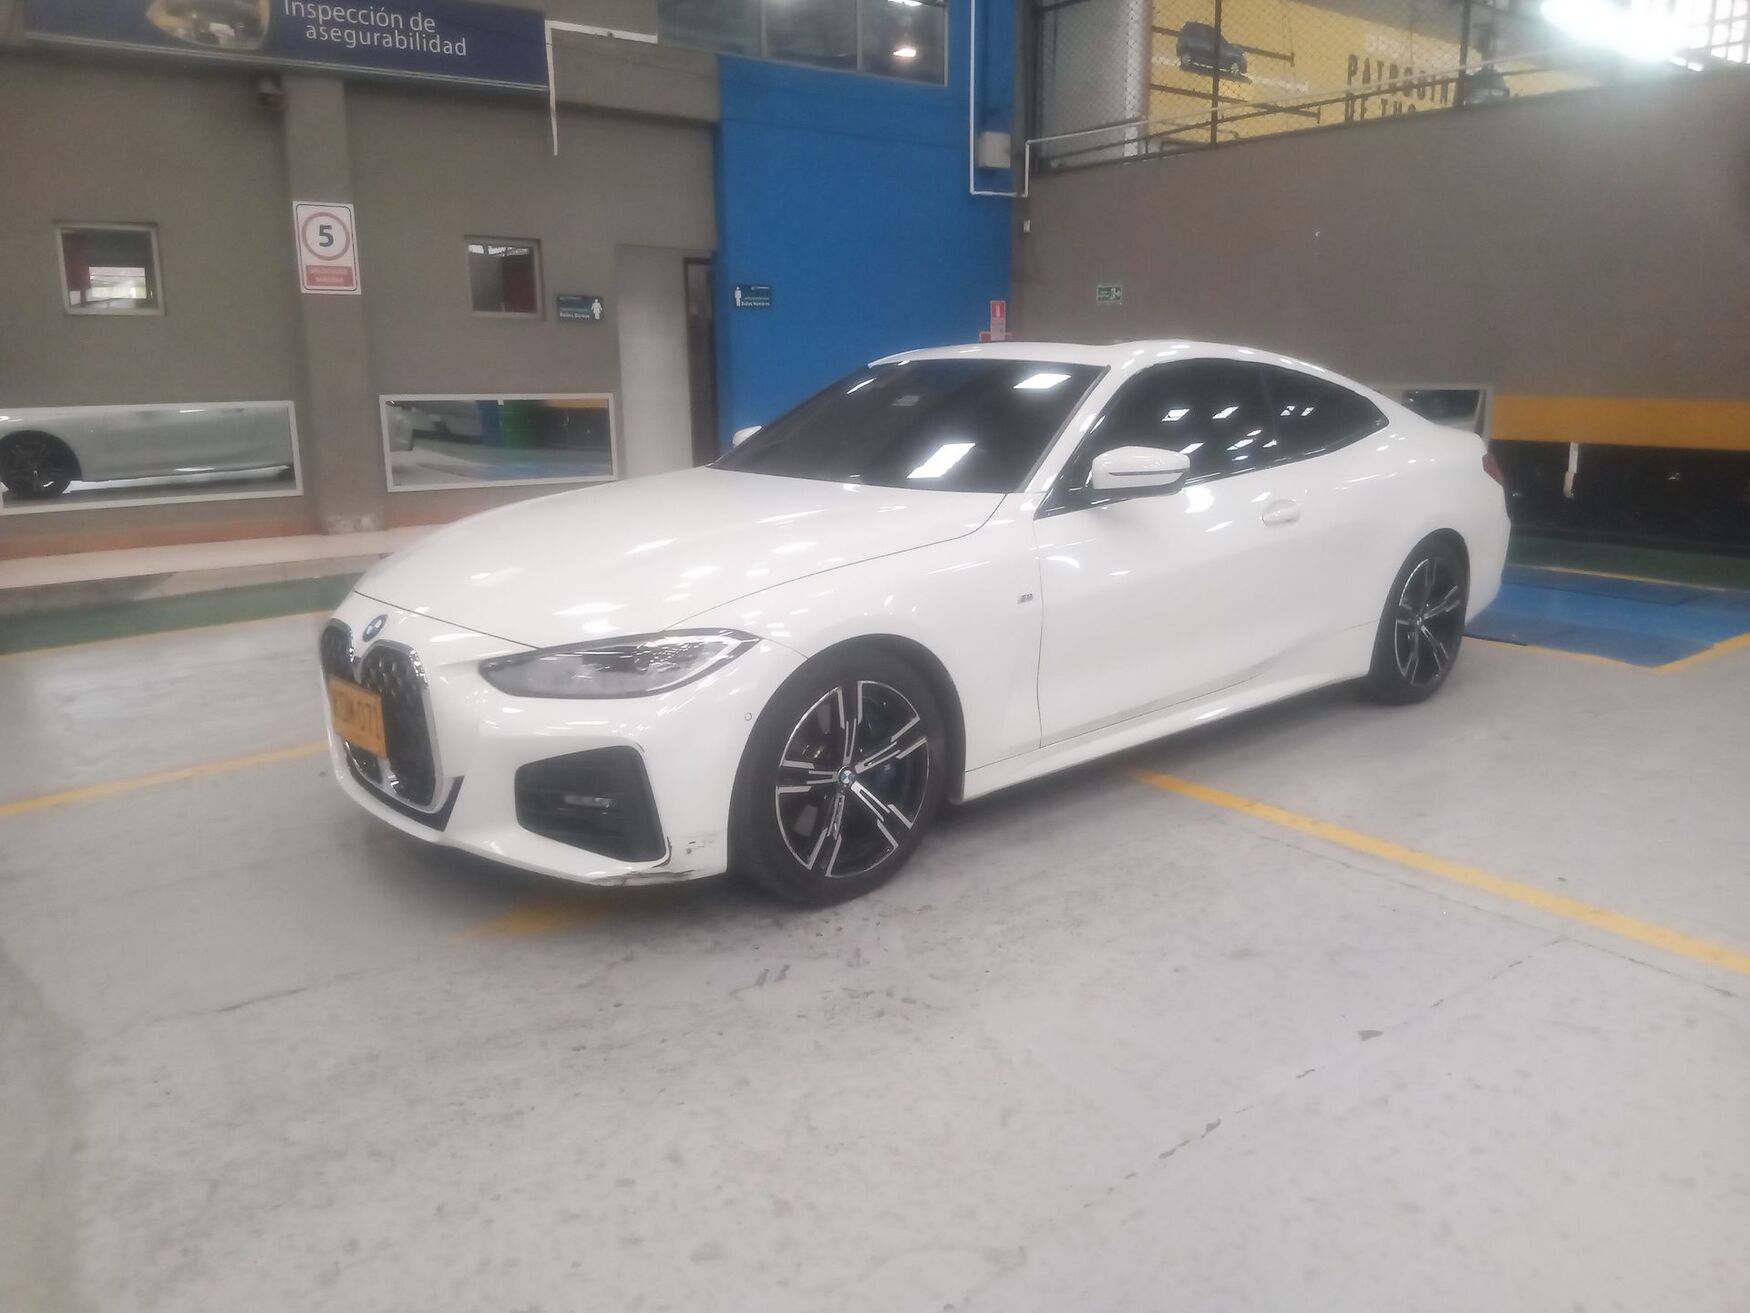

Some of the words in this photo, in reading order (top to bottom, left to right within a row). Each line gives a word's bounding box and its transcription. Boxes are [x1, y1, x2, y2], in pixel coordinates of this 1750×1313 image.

[284, 0, 403, 29] Inspección
[410, 12, 436, 32] de
[306, 24, 467, 57] asegurabilidad
[318, 224, 335, 248] 5
